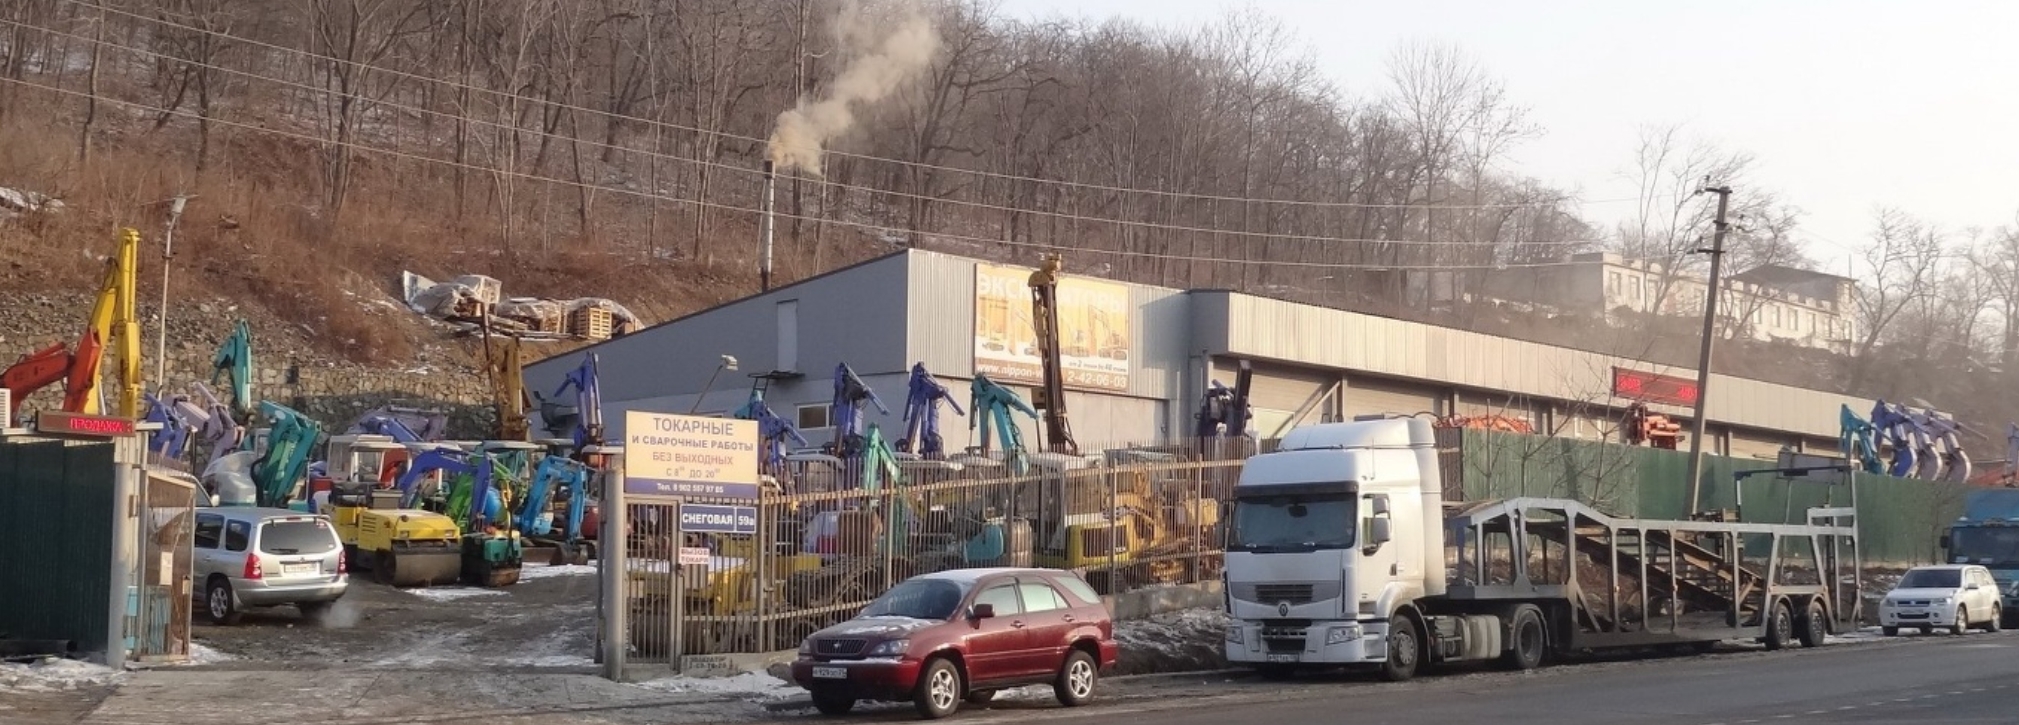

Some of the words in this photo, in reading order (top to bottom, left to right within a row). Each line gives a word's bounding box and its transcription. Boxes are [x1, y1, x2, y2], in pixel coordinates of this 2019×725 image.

[977, 274, 1127, 313] ЭКСКАТОРЫ
[70, 417, 123, 433] ПРОДАЖА
[653, 417, 734, 436] ТОКАРНЫЕ
[632, 435, 639, 444] И
[642, 435, 708, 449] СВАРОЧНЫЕ
[711, 440, 754, 451] РАБОТЫ
[652, 451, 672, 462] БЕЗ
[675, 453, 734, 466] ВЫХОДНЫХ
[666, 468, 672, 476] С
[689, 469, 702, 478] ДО
[682, 512, 733, 525] СНЕГОВАЯ
